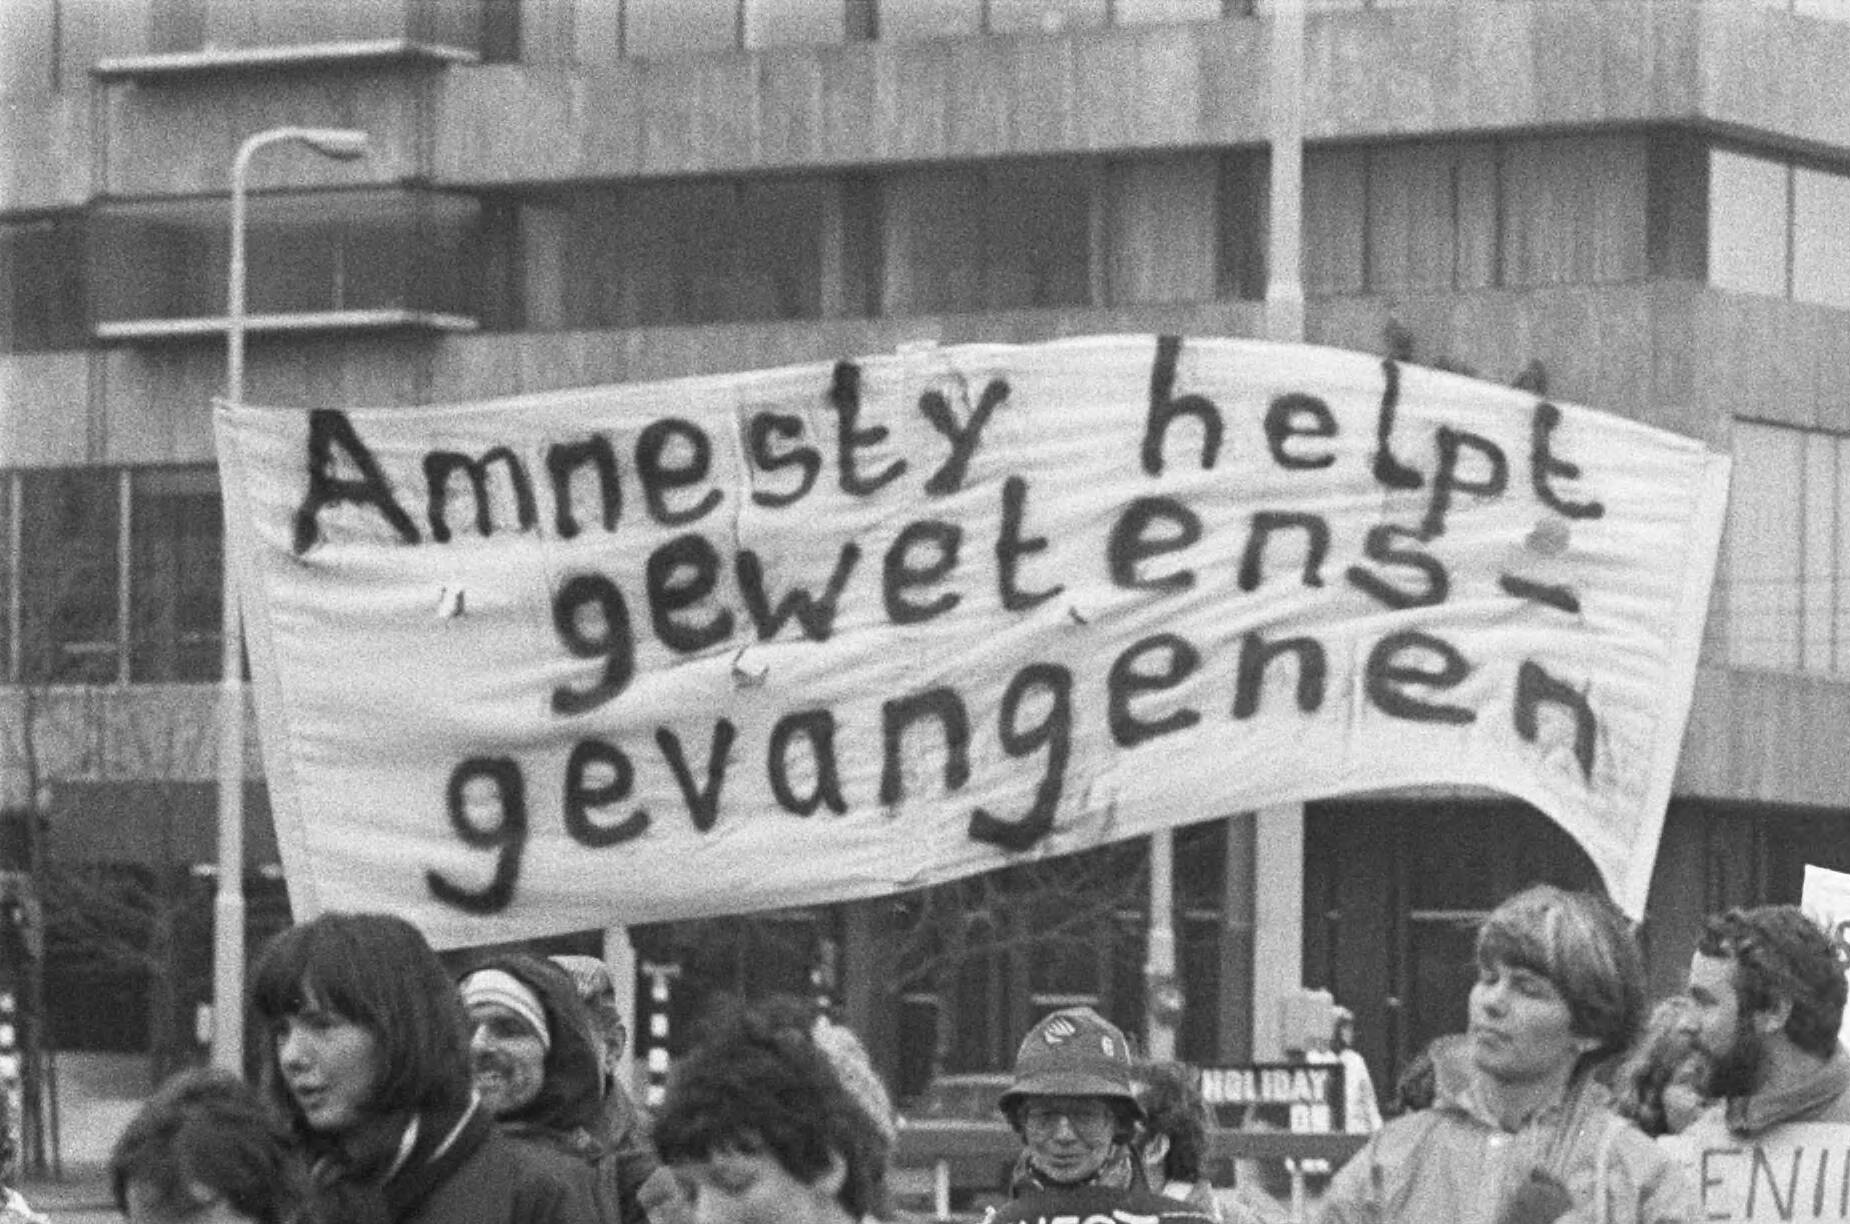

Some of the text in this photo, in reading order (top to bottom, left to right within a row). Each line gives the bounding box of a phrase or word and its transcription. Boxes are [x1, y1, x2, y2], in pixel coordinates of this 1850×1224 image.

[294, 335, 1605, 554] Amnesty helpt
[552, 476, 1580, 715] gewetens-
[426, 631, 1597, 915] gevangenen
[1202, 1069, 1328, 1101] HOLIDAY
